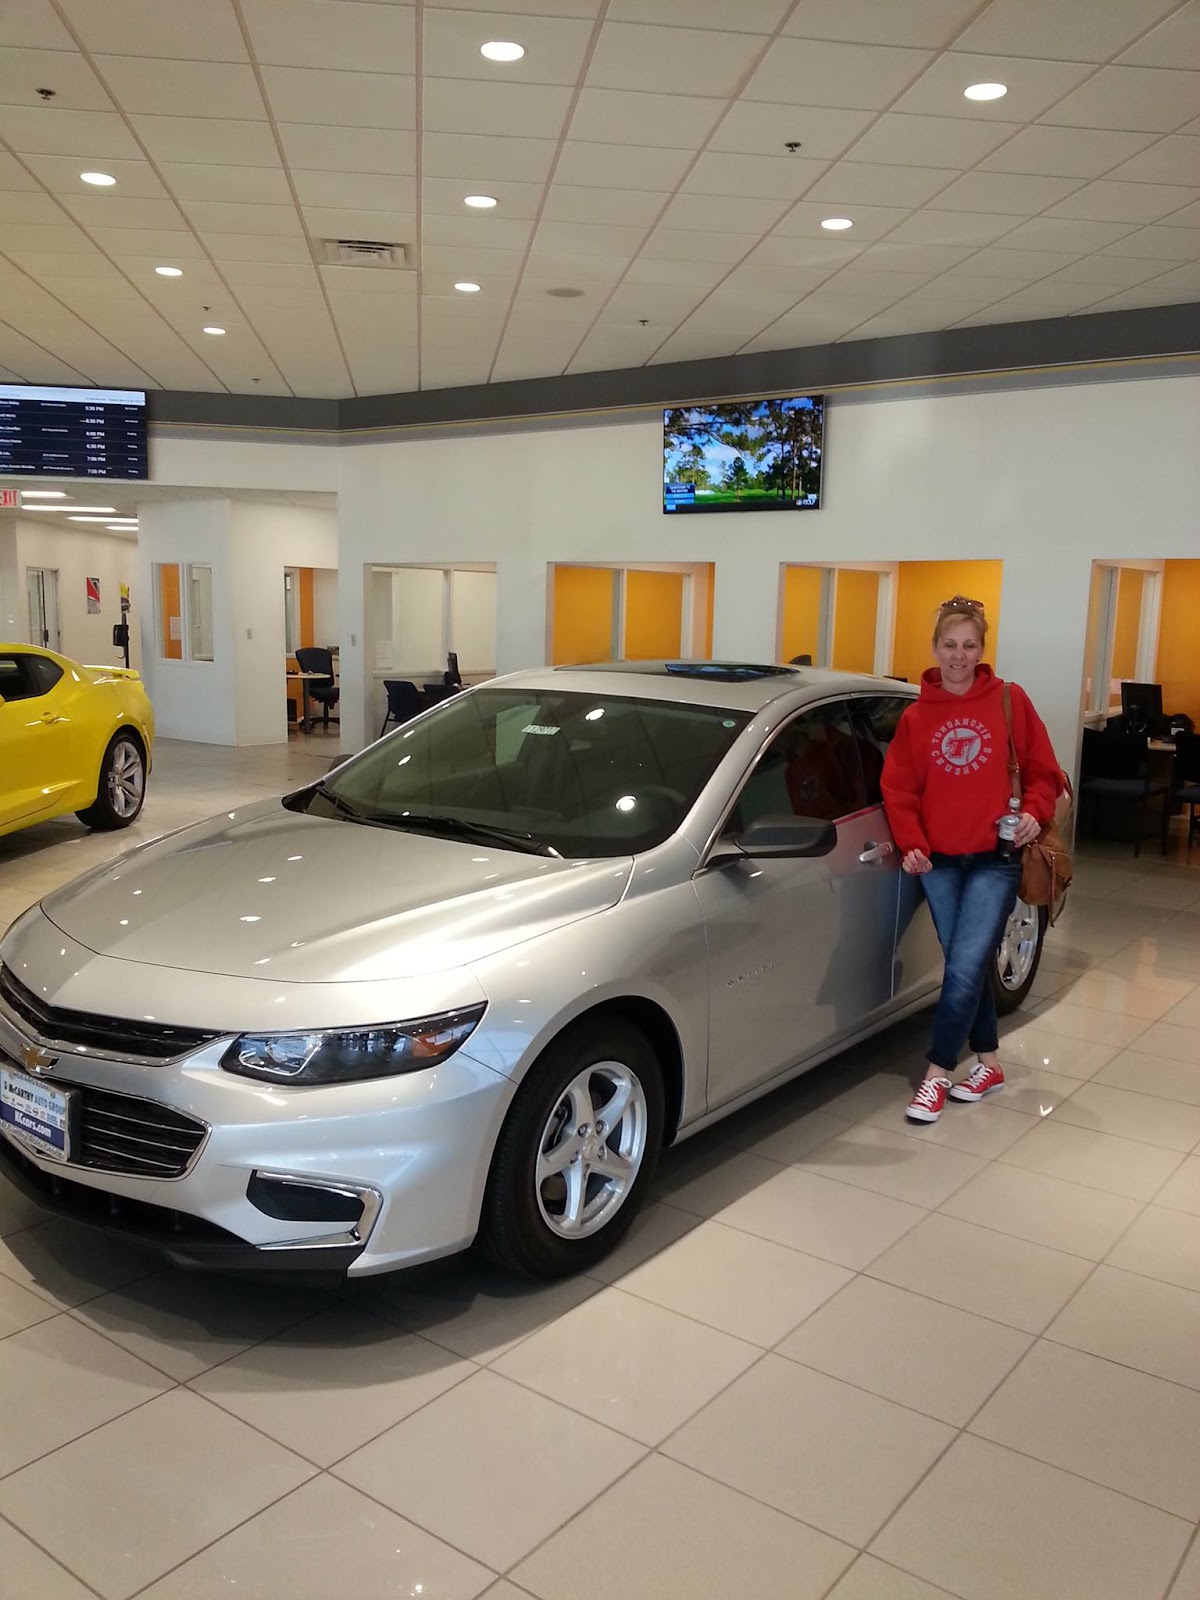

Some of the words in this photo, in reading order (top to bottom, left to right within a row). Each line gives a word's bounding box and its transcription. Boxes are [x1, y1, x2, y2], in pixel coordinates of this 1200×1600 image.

[8, 1083, 34, 1102] McCARTHY
[34, 1094, 48, 1108] AUTO
[14, 1110, 52, 1138] KCcars.com
